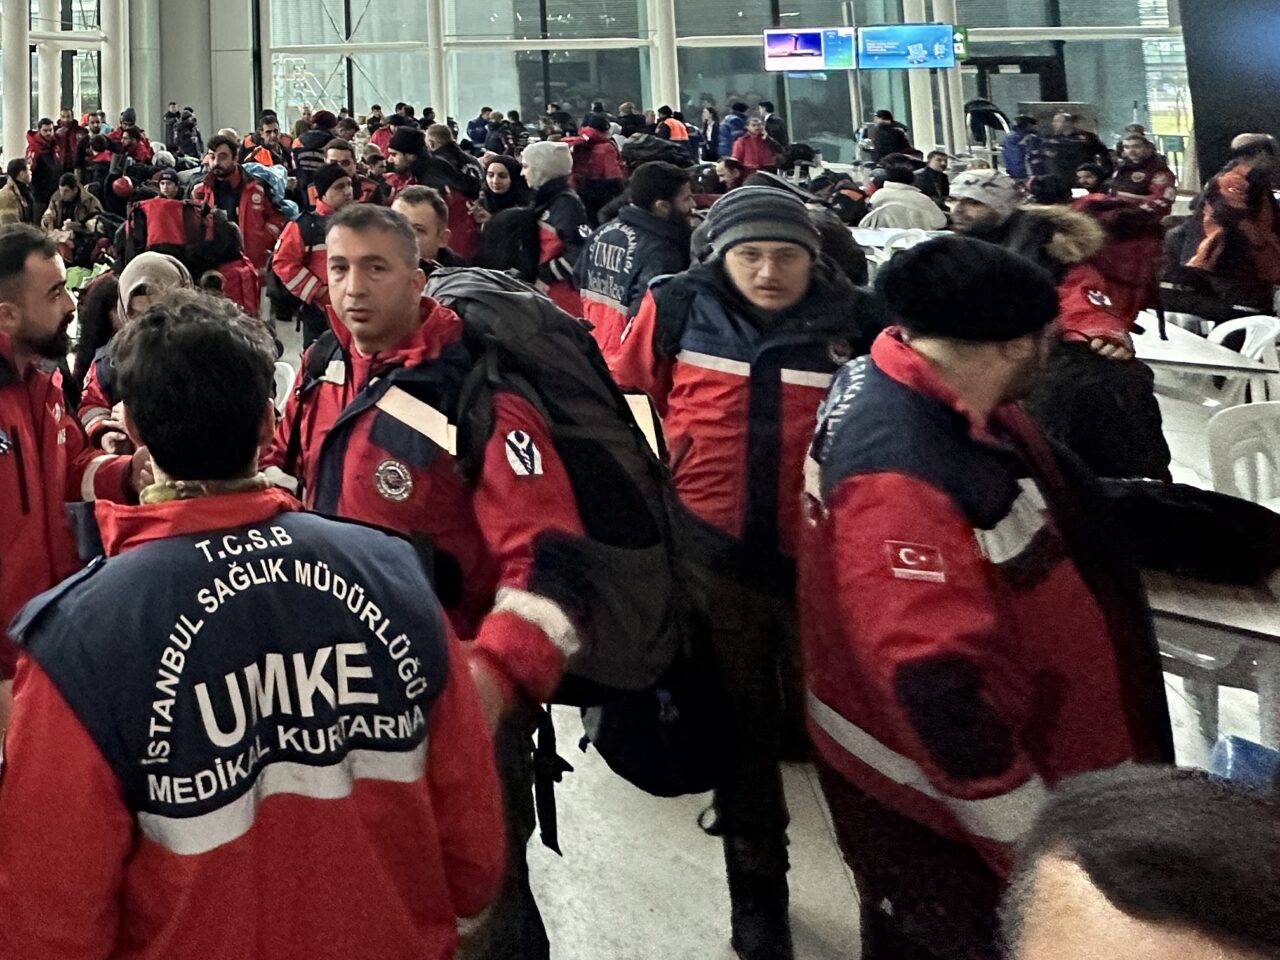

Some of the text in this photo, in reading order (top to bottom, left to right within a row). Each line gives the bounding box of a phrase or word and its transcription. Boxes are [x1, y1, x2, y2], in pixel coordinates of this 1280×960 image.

[140, 557, 428, 765] İSTANBUL SAĞLIK MÜDÜRLÜĞÜ
[194, 642, 379, 747] UMKE
[147, 704, 425, 804] MEDİKAL KURTARMA
